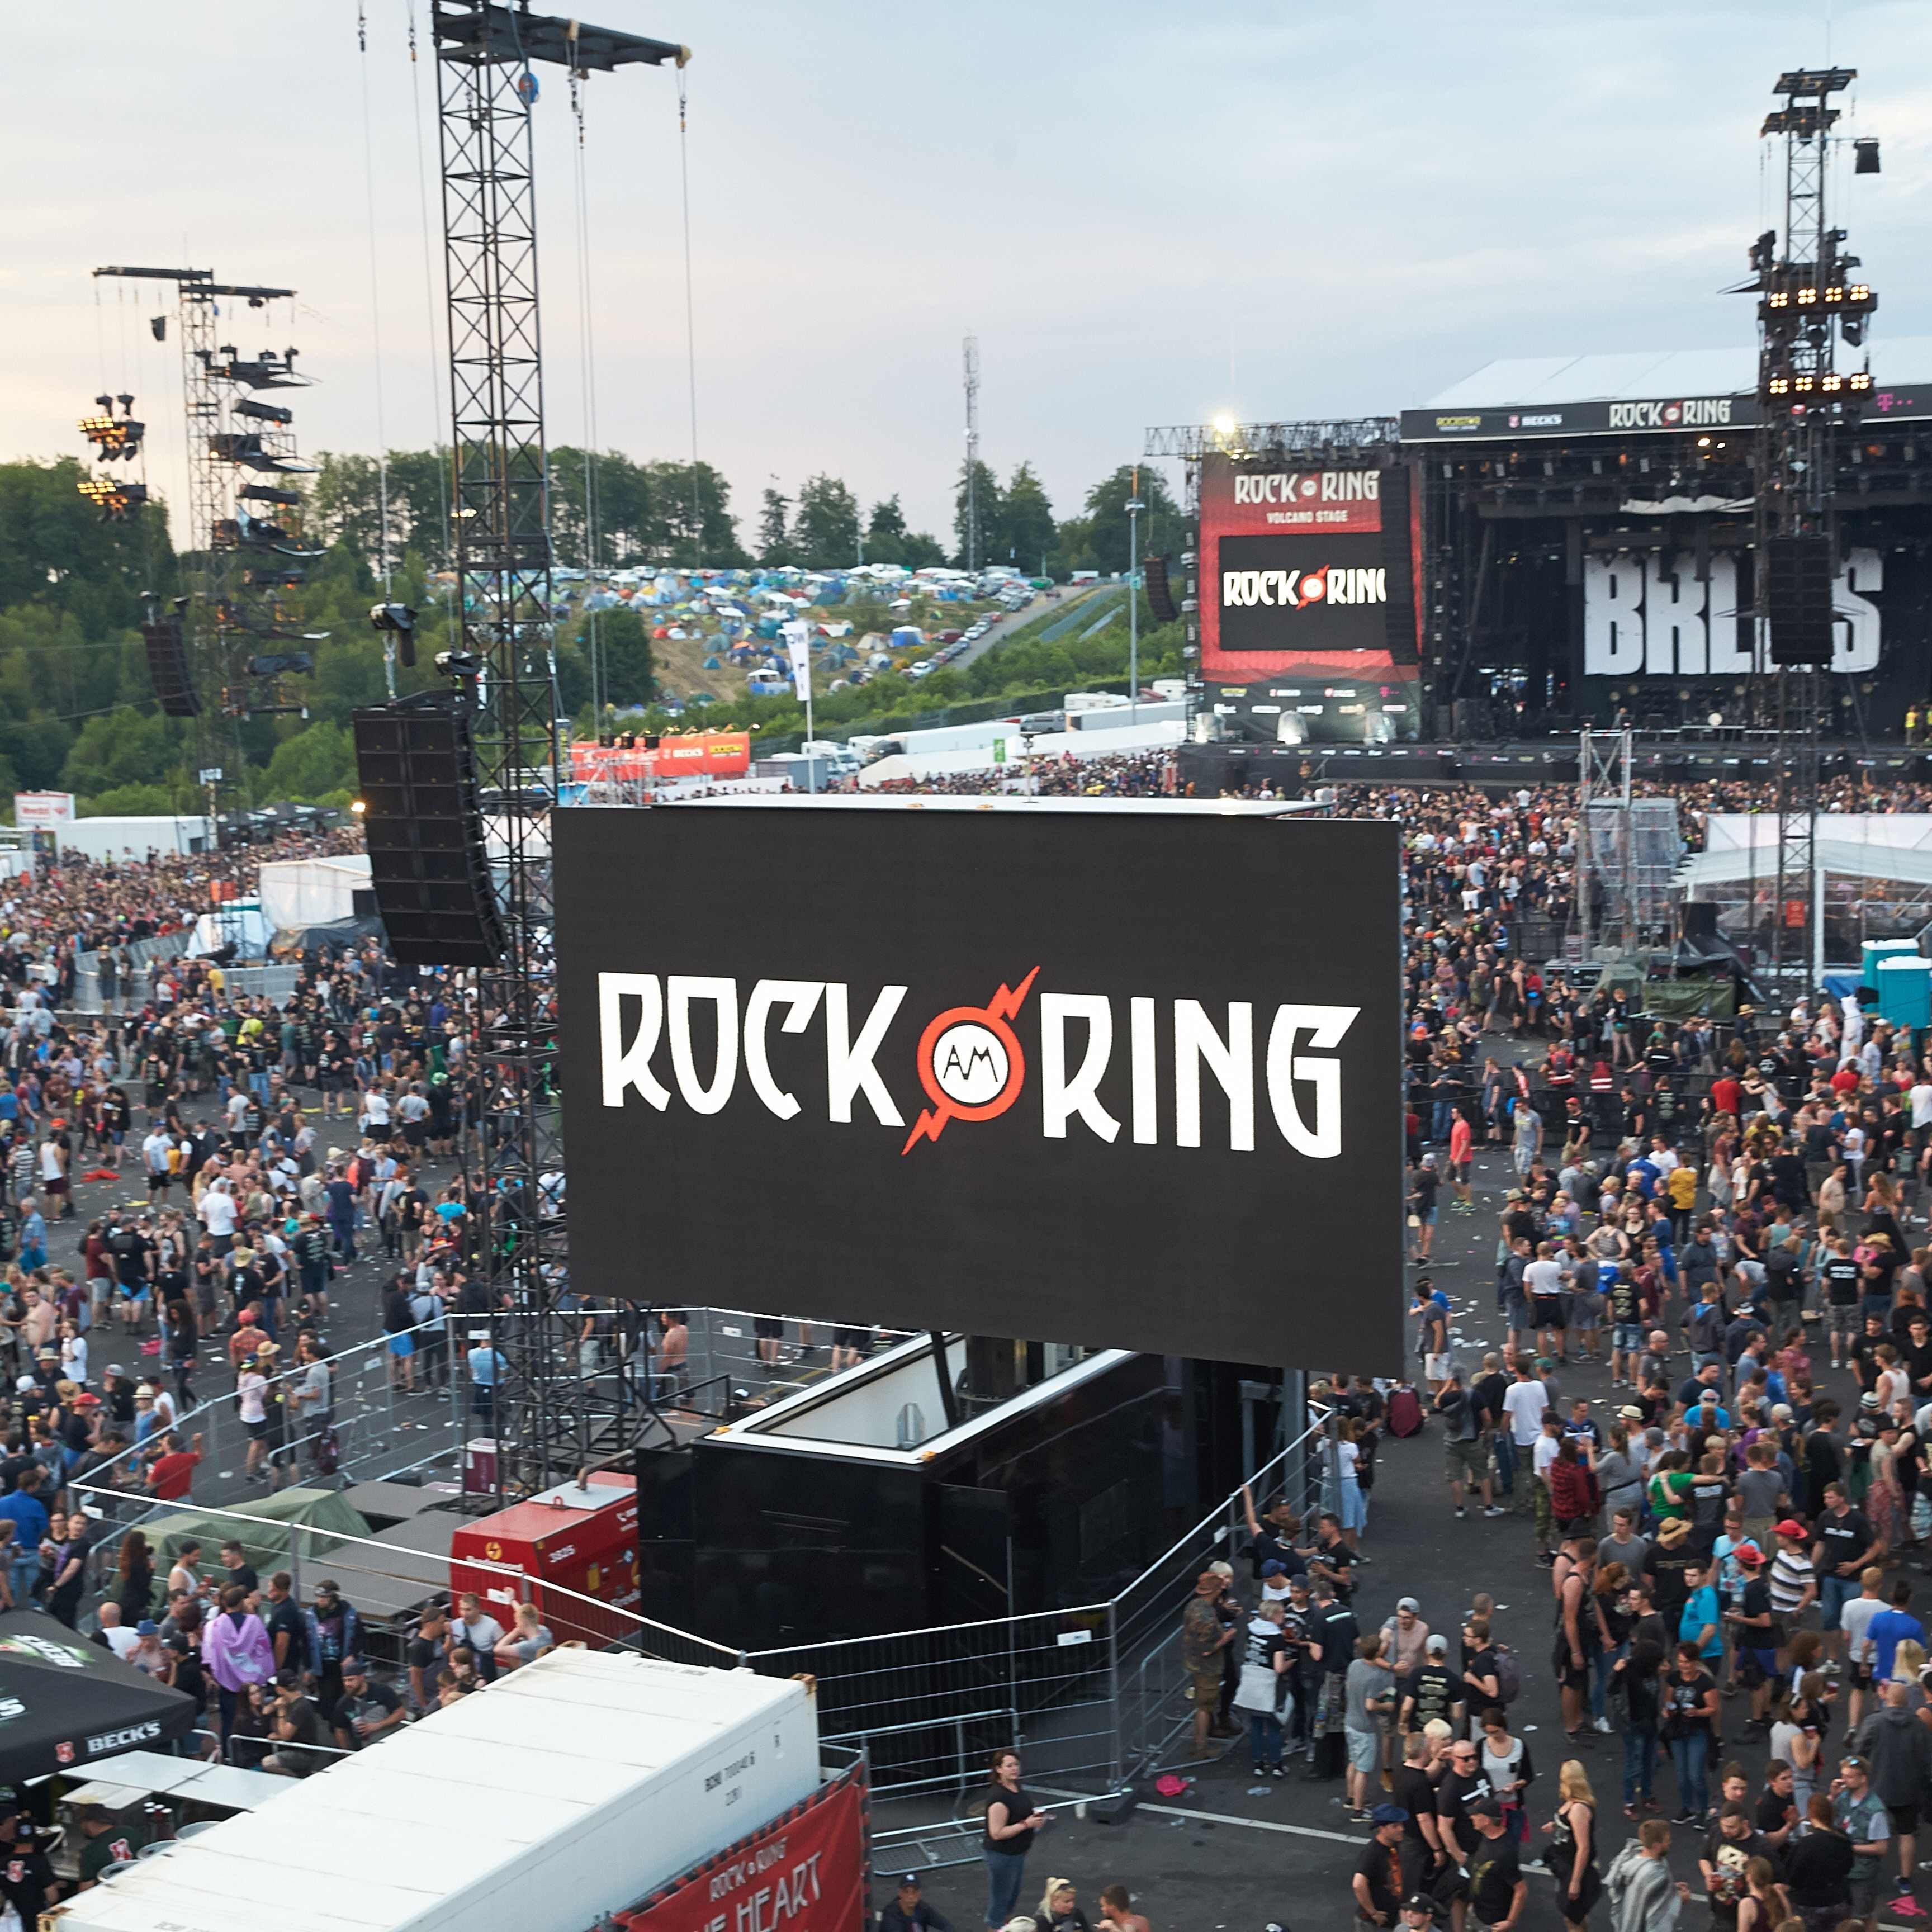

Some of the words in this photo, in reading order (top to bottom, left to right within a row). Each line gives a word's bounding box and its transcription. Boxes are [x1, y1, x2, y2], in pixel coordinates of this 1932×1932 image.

[1609, 402, 1664, 428] ROCK
[1682, 399, 1732, 424] RING
[1234, 474, 1298, 504] ROCK
[1321, 470, 1381, 501] RING
[1266, 510, 1314, 524] VOLCANO
[1315, 509, 1349, 523] STAGE
[1223, 570, 1301, 607] ROCK
[598, 972, 908, 1128] ROCK
[943, 1044, 998, 1082] AM
[1040, 992, 1361, 1159] RING
[87, 1721, 162, 1753] BECK'S
